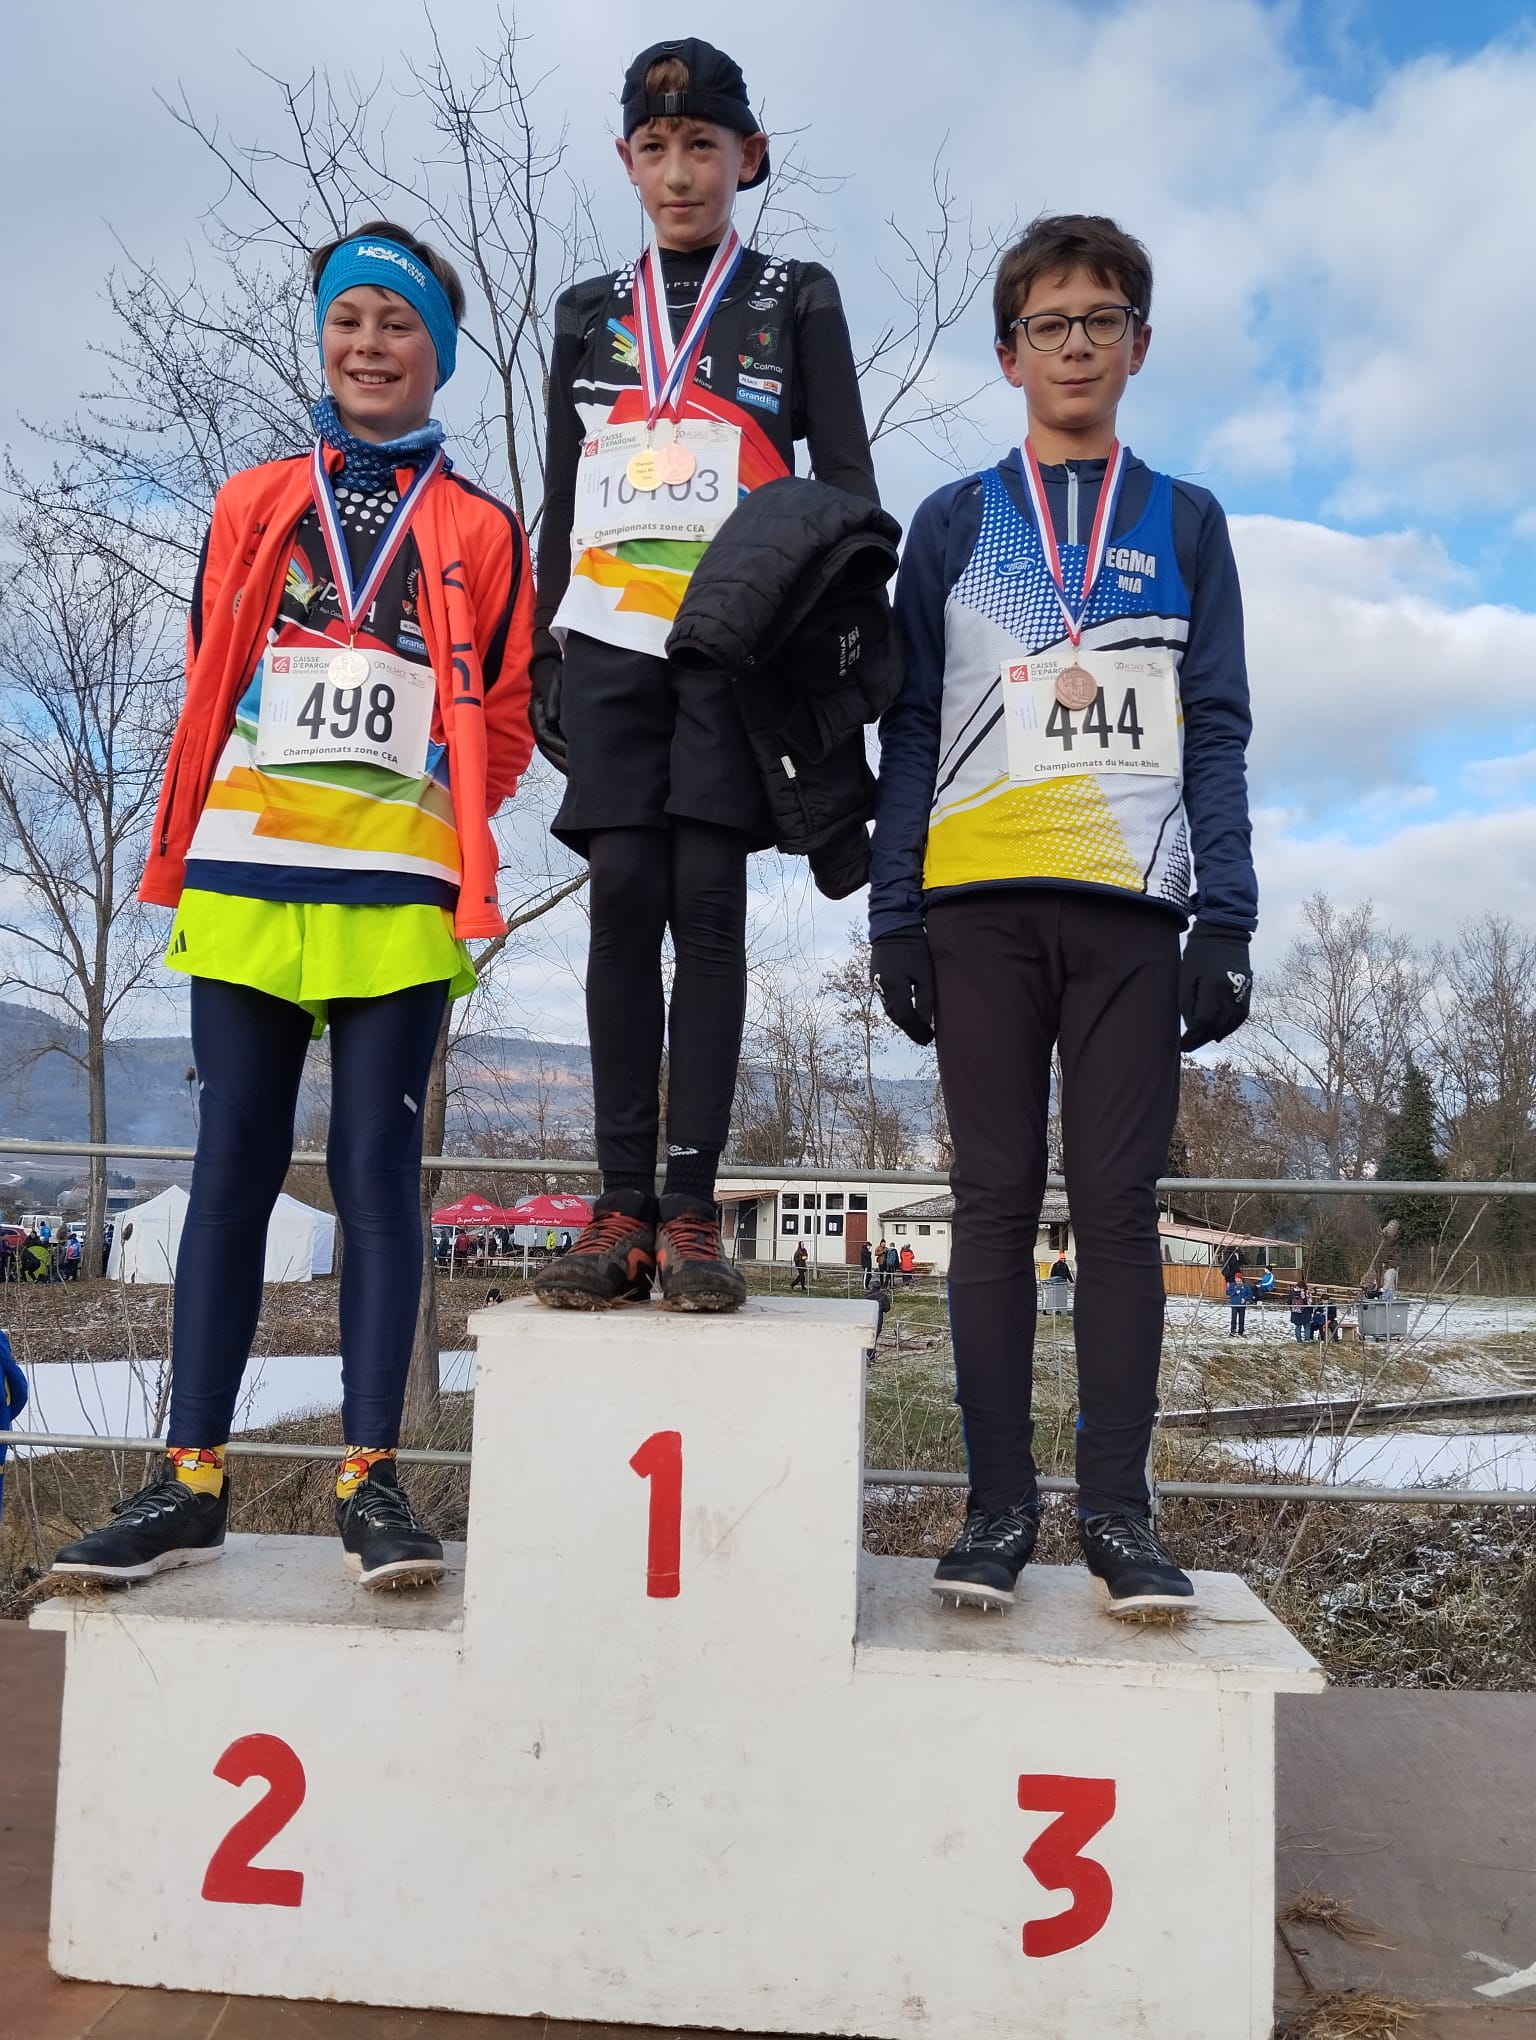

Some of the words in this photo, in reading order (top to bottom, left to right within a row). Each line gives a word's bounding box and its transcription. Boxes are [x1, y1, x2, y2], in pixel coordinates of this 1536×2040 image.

[356, 246, 408, 271] HOKA
[665, 281, 704, 289] IPST
[753, 362, 784, 374] Colmar
[738, 389, 765, 402] Grand
[600, 432, 624, 442] CAISSE
[594, 523, 657, 538] Championnats
[660, 524, 684, 532] zone
[687, 524, 705, 533] CEA
[1117, 575, 1142, 594] MIA
[398, 636, 425, 650] Grand
[1030, 661, 1058, 669] CAISSE
[1031, 667, 1066, 676] D'EPARG
[296, 682, 395, 743] 498
[1045, 686, 1145, 752] 444
[283, 746, 352, 757] Championnats
[354, 747, 378, 756] zone
[381, 750, 398, 764] CEA
[1034, 760, 1103, 772] Championnats
[1105, 758, 1117, 766] du
[1118, 759, 1160, 768] Haut-Rhin
[631, 1432, 682, 1597] 1
[203, 1735, 305, 1906] 2
[1019, 1775, 1114, 1956] 3
